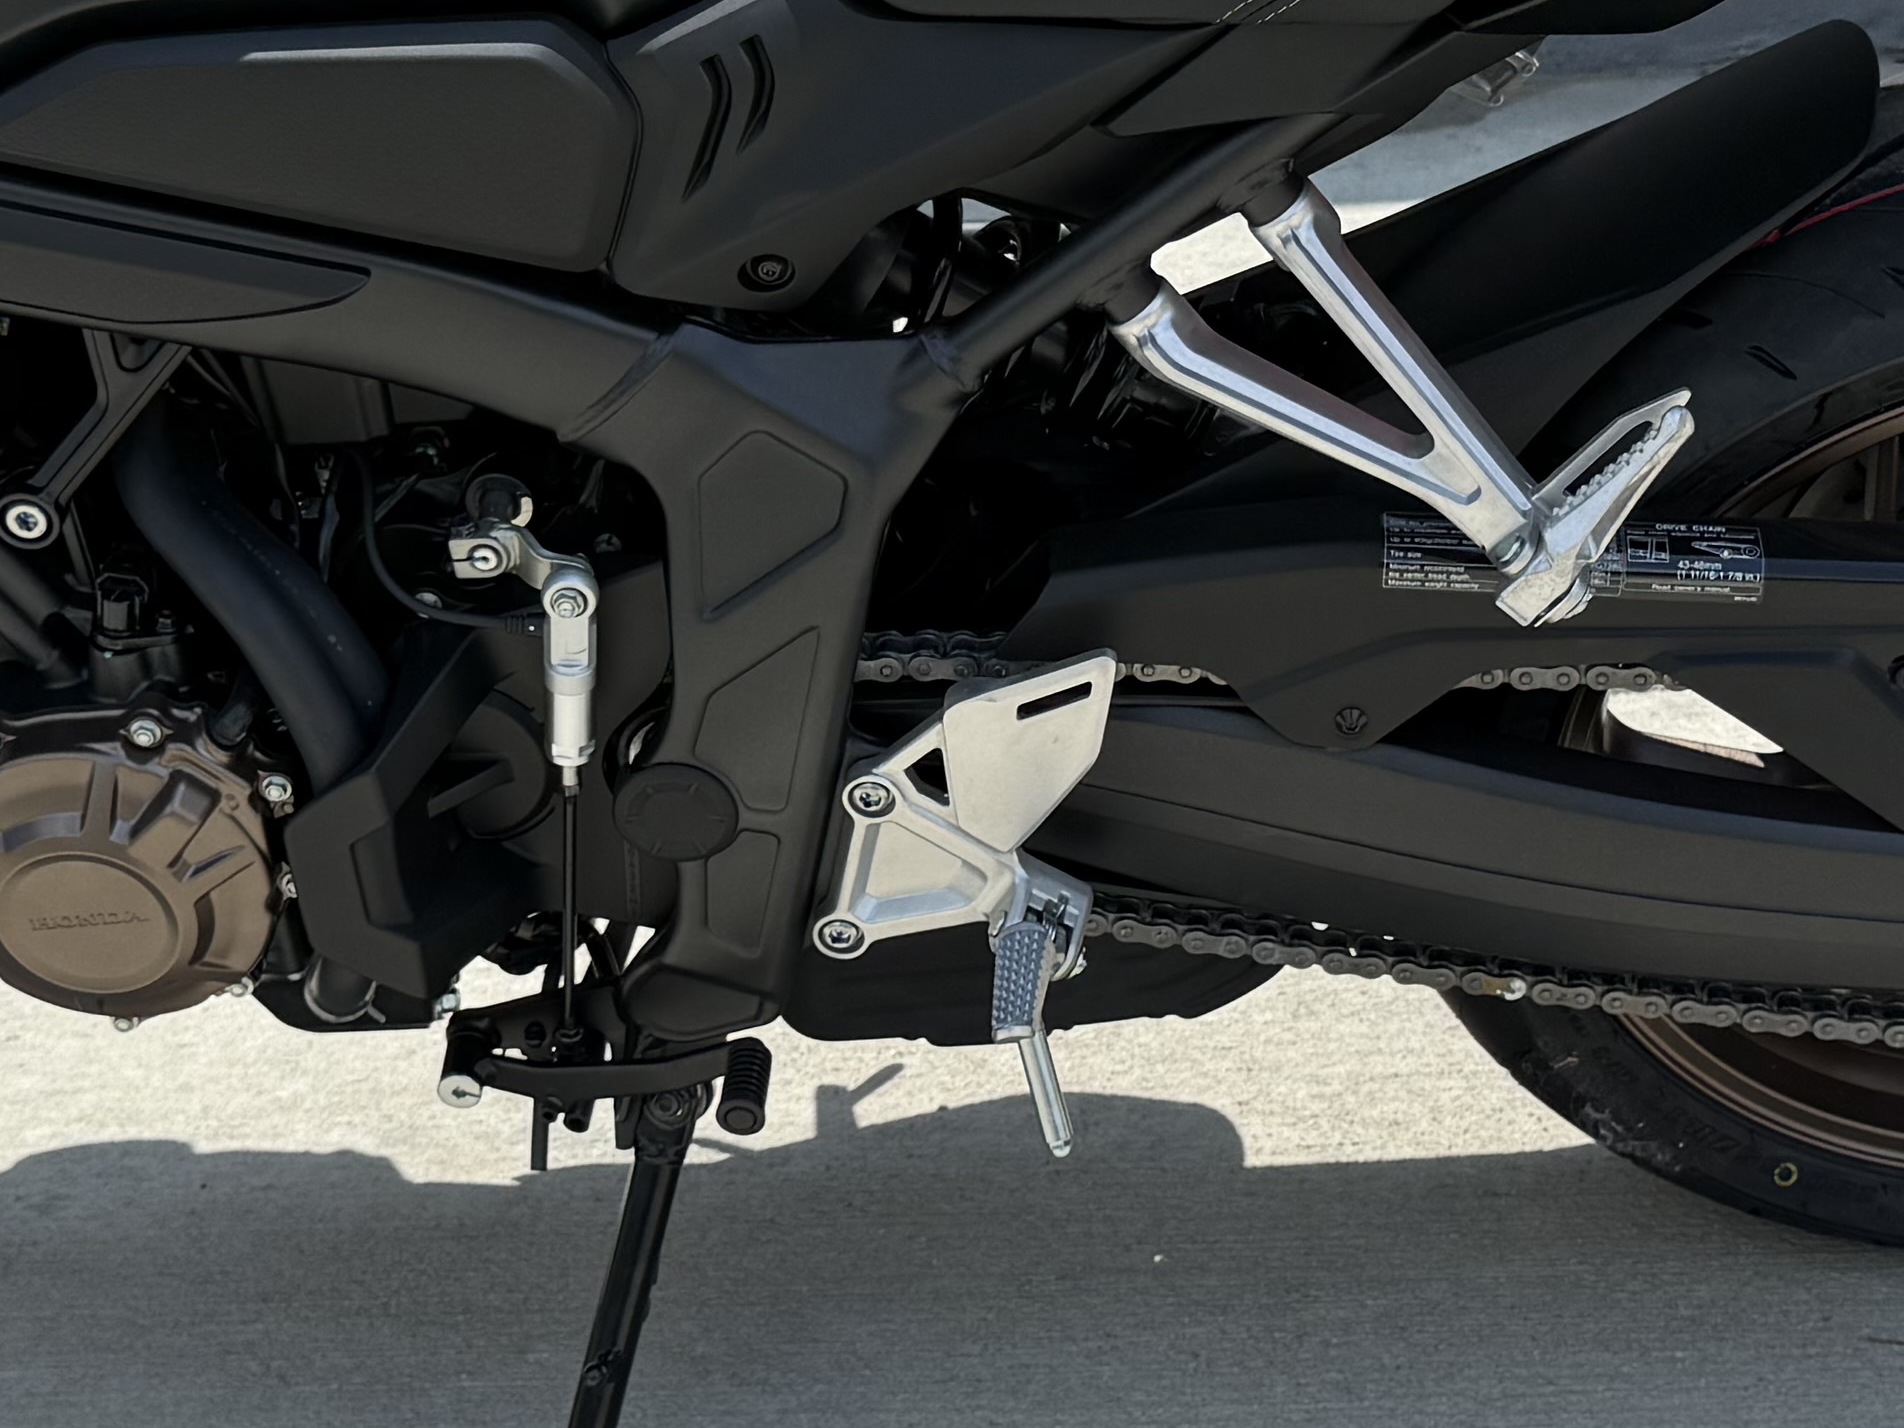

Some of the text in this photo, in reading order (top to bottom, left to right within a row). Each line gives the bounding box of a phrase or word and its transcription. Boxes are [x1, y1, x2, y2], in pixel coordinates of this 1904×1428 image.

[1655, 523, 1726, 533] DRIVE CHAIN
[29, 910, 149, 931] HONDA
